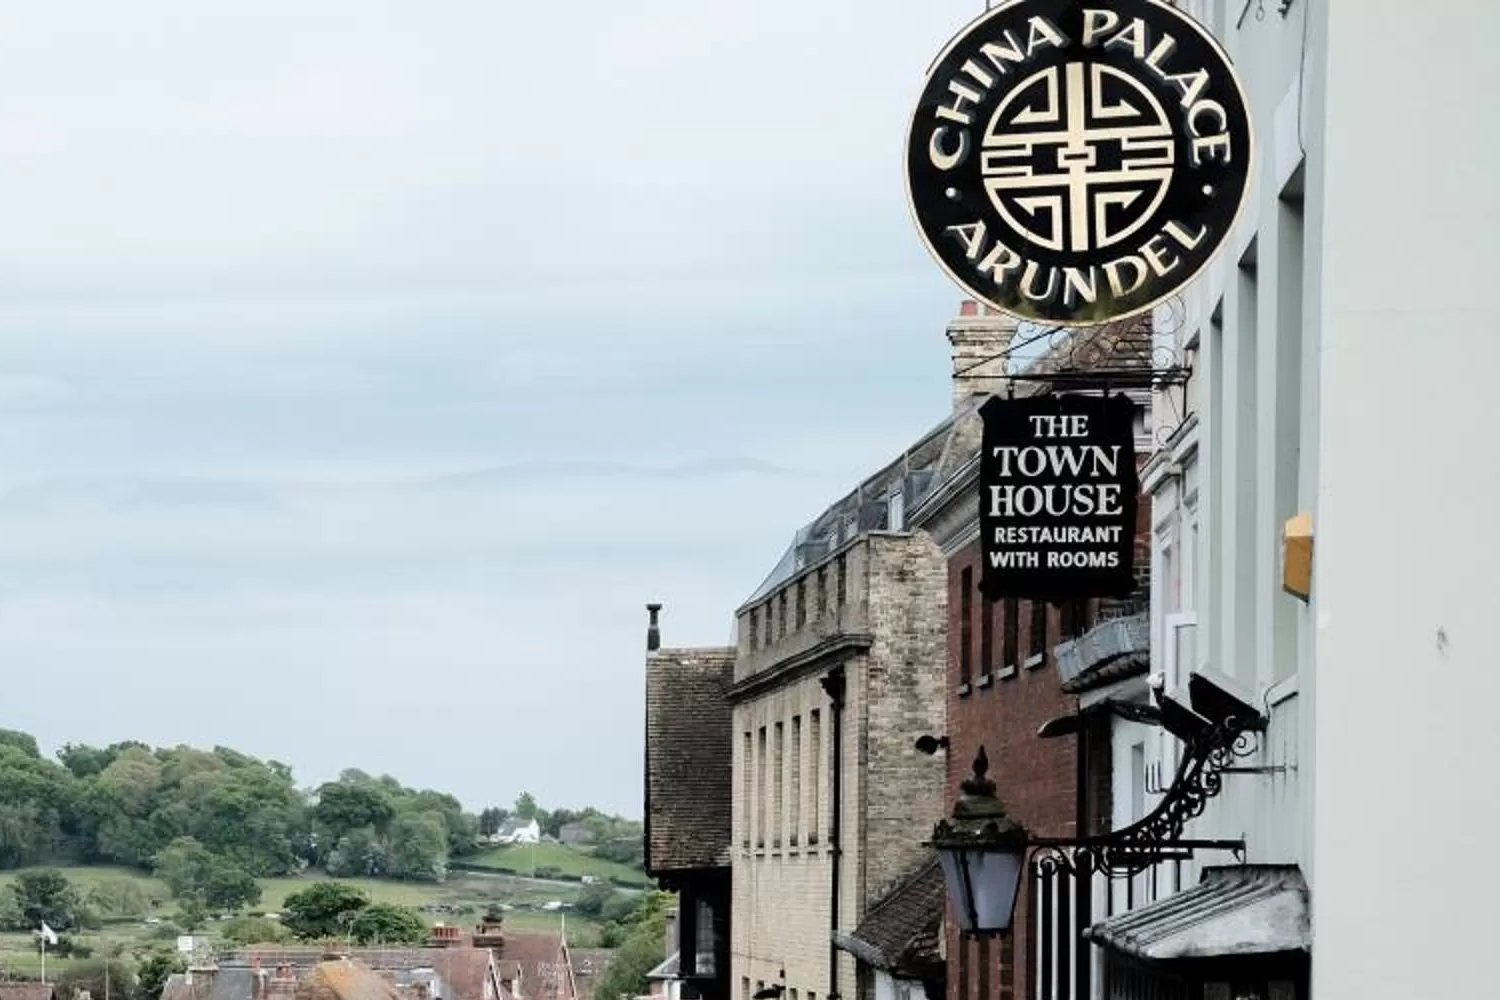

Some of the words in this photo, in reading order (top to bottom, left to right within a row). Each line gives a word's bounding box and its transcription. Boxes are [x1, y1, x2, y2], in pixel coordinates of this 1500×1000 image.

[929, 15, 1065, 171] CHINA
[1082, 9, 1232, 165] PALACE
[947, 219, 1207, 305] ARUNDEL
[1029, 415, 1089, 437] THE
[993, 445, 1122, 477] TOWN
[988, 484, 1123, 516] HOUSE
[994, 526, 1123, 544] RESTAURANT
[990, 551, 1039, 568] WITH
[1047, 551, 1120, 568] ROOMS
